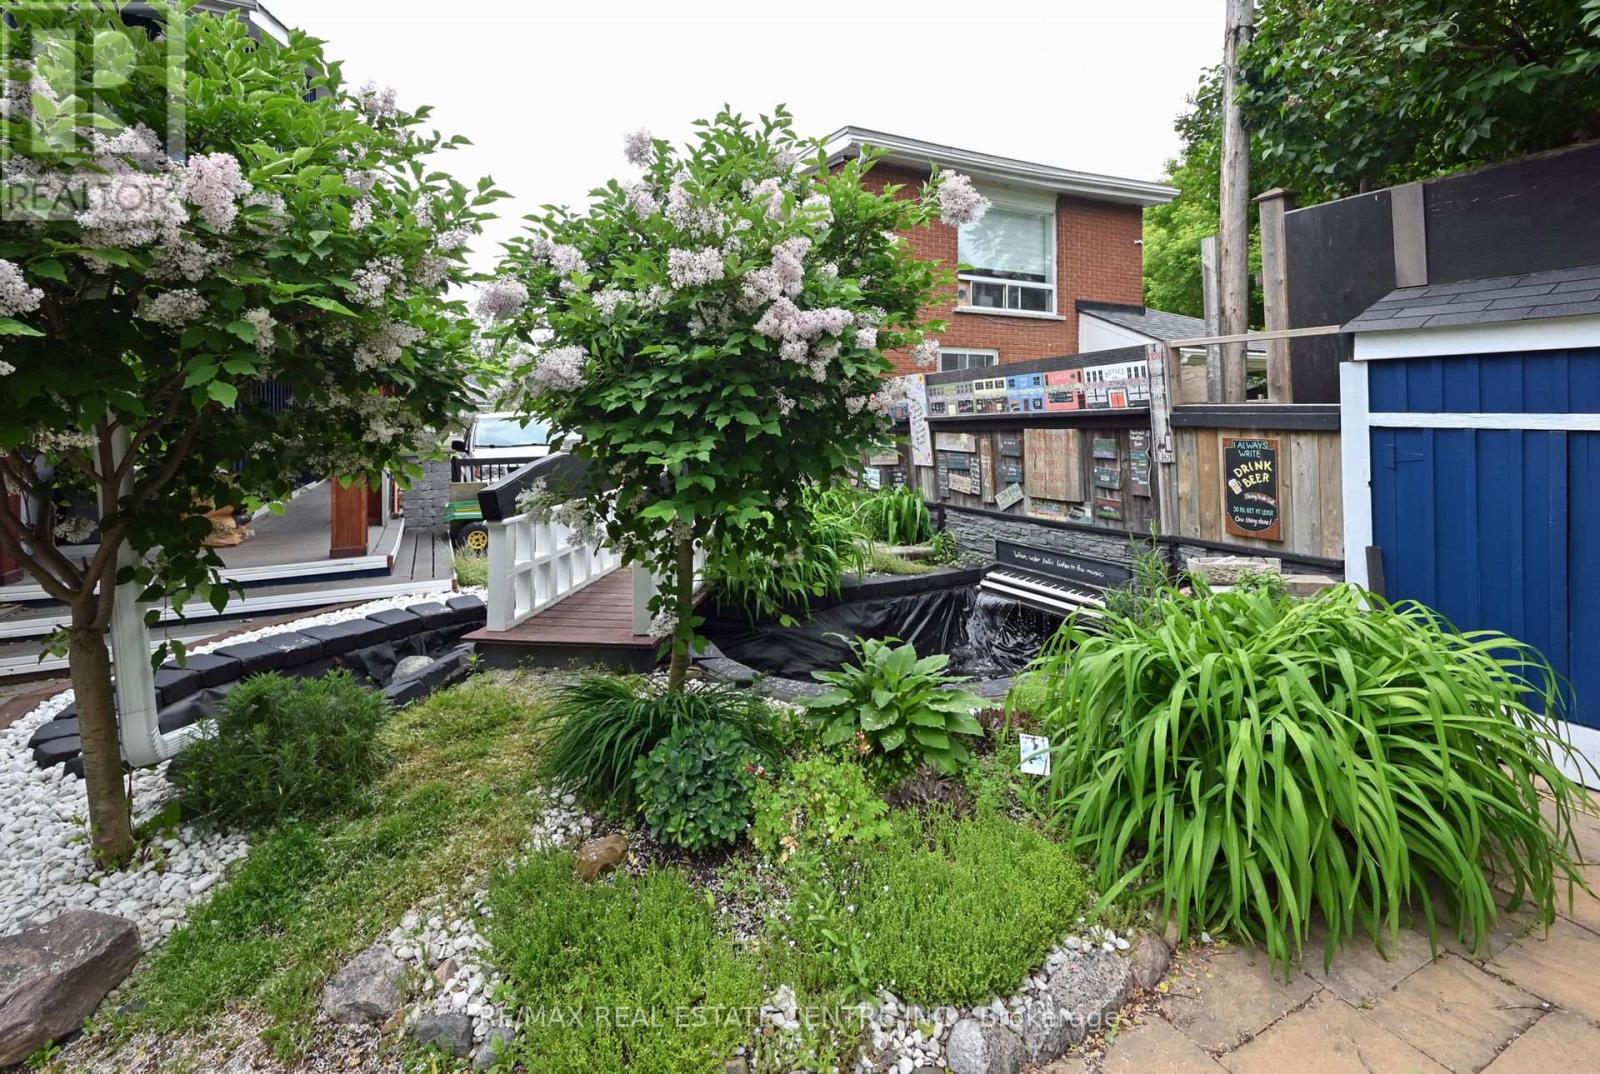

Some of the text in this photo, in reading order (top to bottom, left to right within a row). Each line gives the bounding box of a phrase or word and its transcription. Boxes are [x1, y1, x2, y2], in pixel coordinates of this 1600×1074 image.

[1237, 441, 1268, 450] ALWAYS
[1238, 450, 1261, 458] WRITE
[1233, 460, 1273, 478] DRINK
[1242, 472, 1270, 488] BEER
